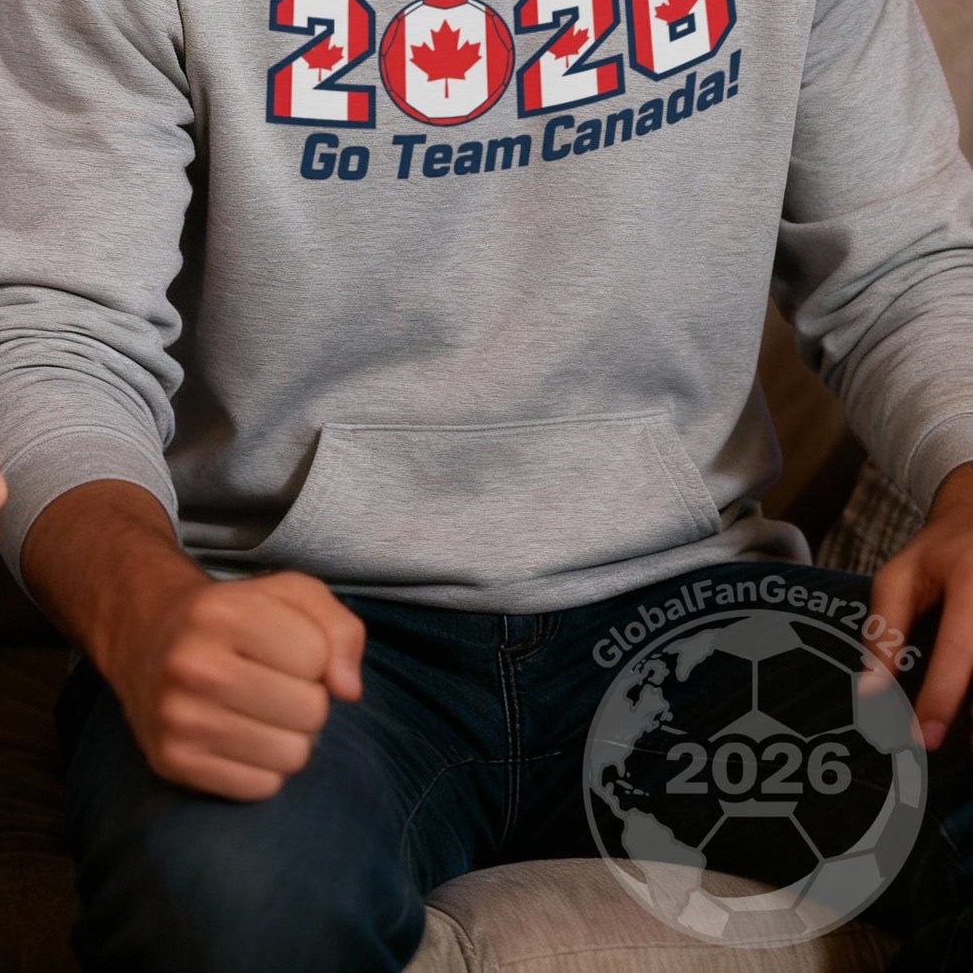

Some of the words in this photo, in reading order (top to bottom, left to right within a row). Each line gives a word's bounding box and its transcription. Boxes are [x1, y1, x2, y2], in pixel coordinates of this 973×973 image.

[299, 132, 370, 181] Go
[391, 133, 532, 179] Team
[541, 48, 742, 163] Canada!
